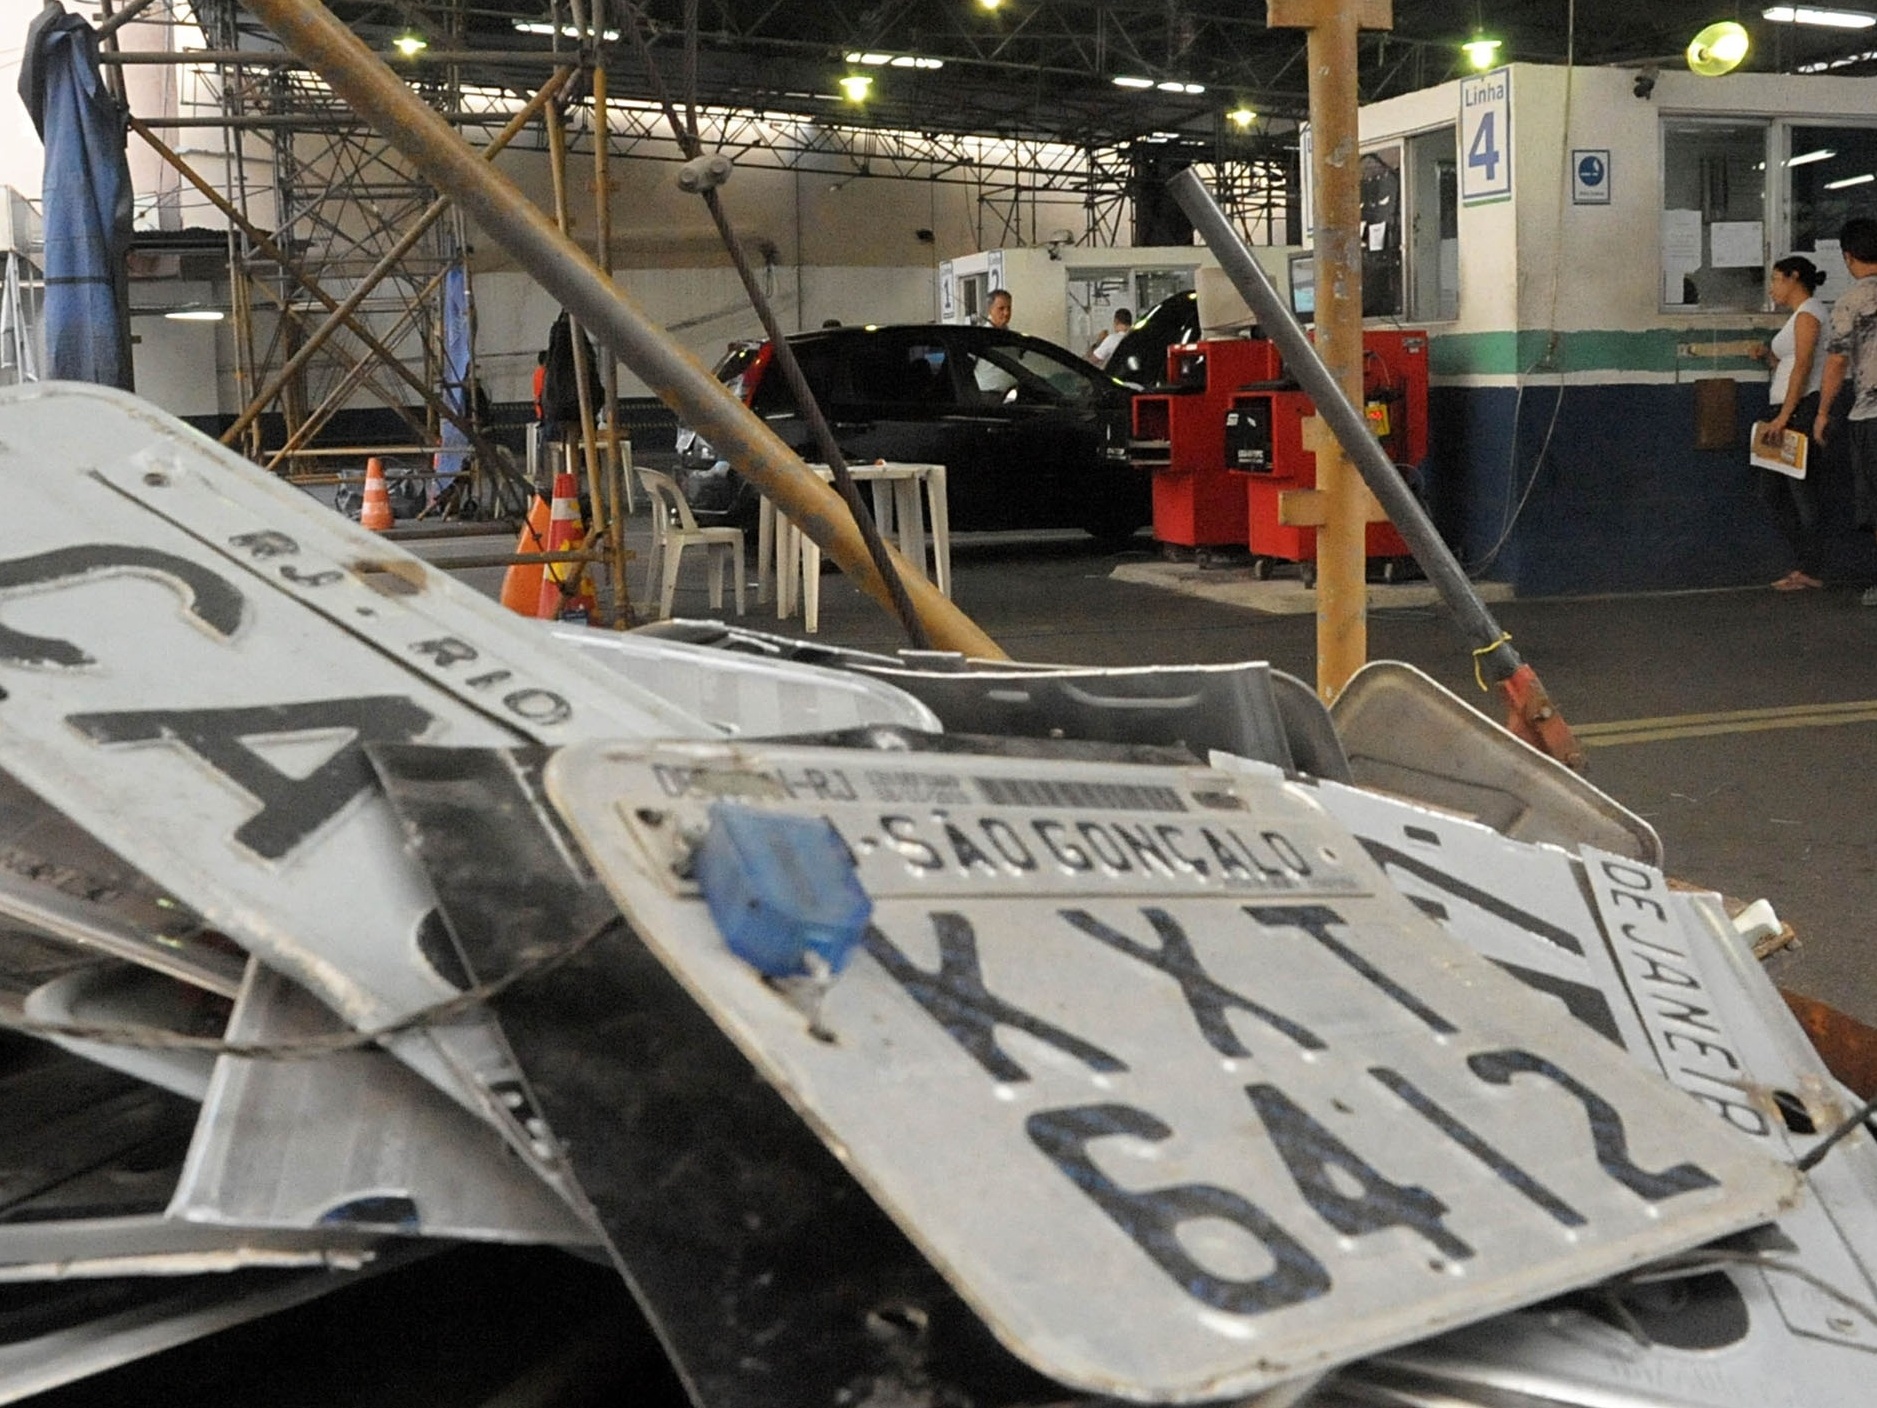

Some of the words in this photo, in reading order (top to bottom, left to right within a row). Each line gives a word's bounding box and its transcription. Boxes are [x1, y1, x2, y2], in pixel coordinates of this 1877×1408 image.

[1465, 83, 1504, 107] Linha
[1468, 111, 1499, 180] 4
[943, 279, 952, 309] 1
[1031, 819, 1311, 878] GONÇALO
[1601, 860, 1668, 923] DE
[862, 904, 1461, 1083] KXT
[1026, 1049, 1722, 1315] 6412
